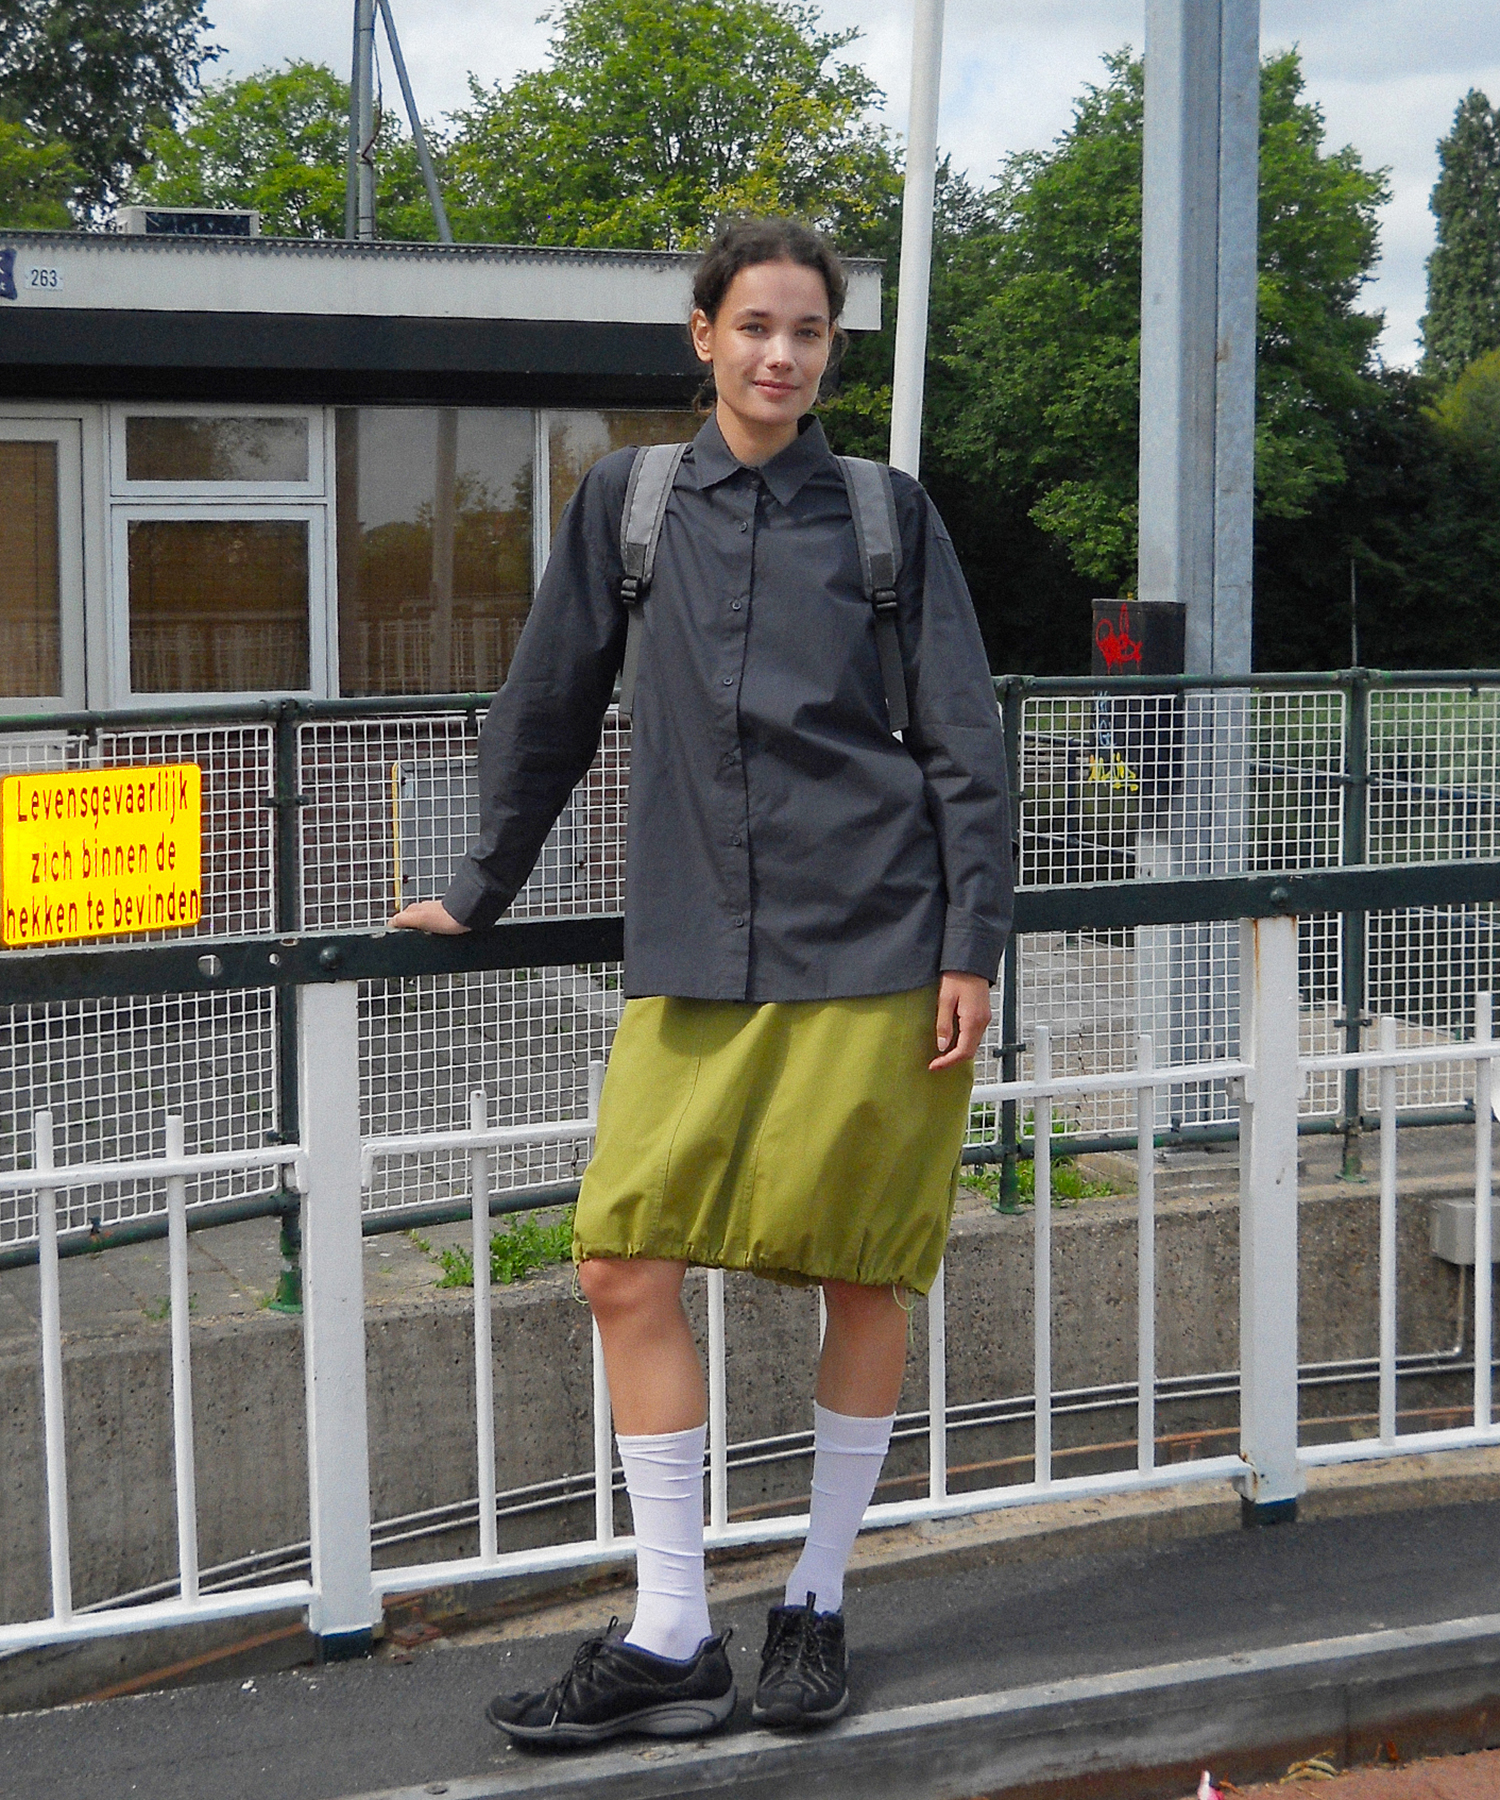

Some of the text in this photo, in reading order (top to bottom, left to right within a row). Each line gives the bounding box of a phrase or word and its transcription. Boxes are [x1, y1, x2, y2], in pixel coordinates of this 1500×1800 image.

[31, 268, 58, 287] 263
[17, 769, 188, 830] Levensgevaarlijk
[31, 832, 176, 884] zich binnen de
[6, 882, 199, 940] hekken te bevinden
